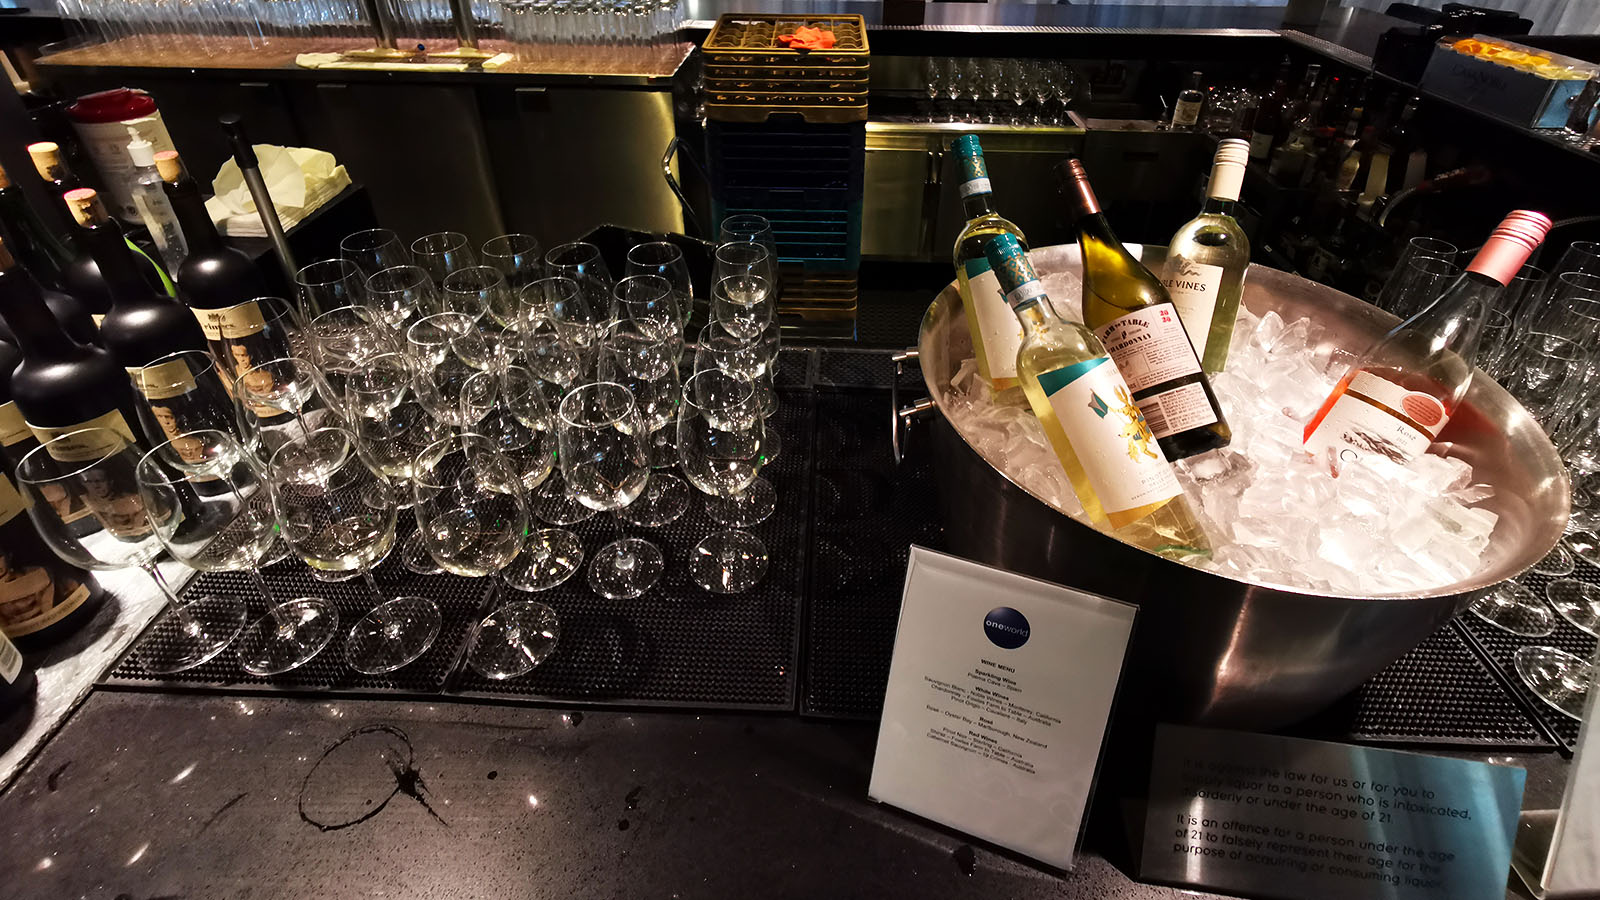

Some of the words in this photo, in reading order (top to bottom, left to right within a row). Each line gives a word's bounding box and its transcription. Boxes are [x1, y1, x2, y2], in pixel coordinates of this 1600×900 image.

[1175, 280, 1206, 292] VINES
[1120, 318, 1150, 328] TABLE
[986, 620, 1028, 637] oneworld
[980, 659, 996, 667] WINE
[997, 664, 1015, 673] MENU
[975, 669, 1001, 681] Sparkling
[992, 692, 1009, 700] Wines
[981, 735, 997, 743] Wines
[1260, 767, 1281, 778] the
[1284, 768, 1306, 781] law
[1312, 773, 1328, 785] for
[1334, 777, 1347, 787] us
[1353, 780, 1366, 789] or
[1371, 781, 1389, 792] for
[1393, 786, 1417, 797] you
[1422, 789, 1435, 800] to
[1246, 796, 1260, 805] or
[1263, 799, 1302, 811] under
[1306, 801, 1327, 814] the
[1331, 808, 1357, 819] age
[1361, 809, 1375, 821] of
[1267, 783, 1279, 793] to
[1284, 785, 1292, 794] a
[1296, 787, 1342, 801] person
[1347, 793, 1375, 806] who
[1379, 798, 1389, 808] is
[1393, 799, 1472, 820] intoxicated,
[1177, 814, 1184, 824] It
[1188, 815, 1197, 825] is
[1202, 819, 1218, 829] an
[1222, 820, 1270, 836] offence
[1274, 827, 1291, 838] for
[1295, 832, 1304, 841] a
[1309, 833, 1354, 848] person
[1360, 840, 1399, 854] under
[1403, 846, 1424, 858] the
[1428, 850, 1455, 862] age
[1175, 829, 1188, 839] of
[1191, 829, 1202, 840] 21
[1206, 832, 1218, 843] to
[1222, 835, 1263, 850] falsely
[1267, 839, 1330, 858] represent
[1334, 849, 1364, 863] their
[1367, 857, 1393, 868] age
[1398, 859, 1415, 871] for
[1174, 843, 1225, 858] purpose
[1229, 849, 1241, 860] of
[1329, 864, 1400, 886] consuming
